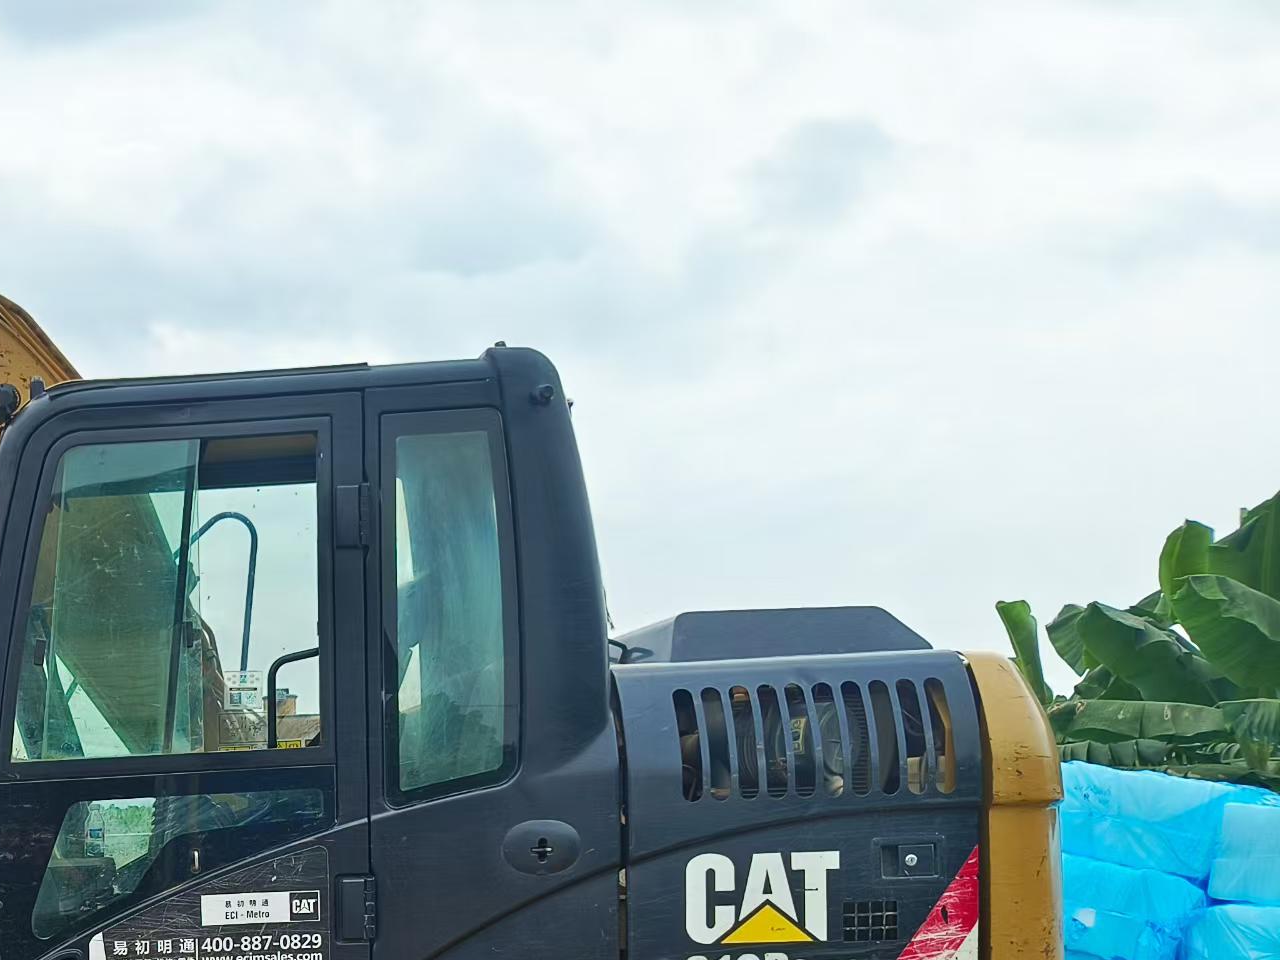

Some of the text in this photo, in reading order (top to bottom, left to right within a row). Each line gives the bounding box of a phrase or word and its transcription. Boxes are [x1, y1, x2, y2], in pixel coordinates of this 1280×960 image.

[685, 850, 840, 945] CAT
[246, 910, 270, 919] Metro
[292, 899, 318, 914] CAT
[113, 938, 195, 955] 易初明通
[201, 934, 322, 952] 400-887-0829
